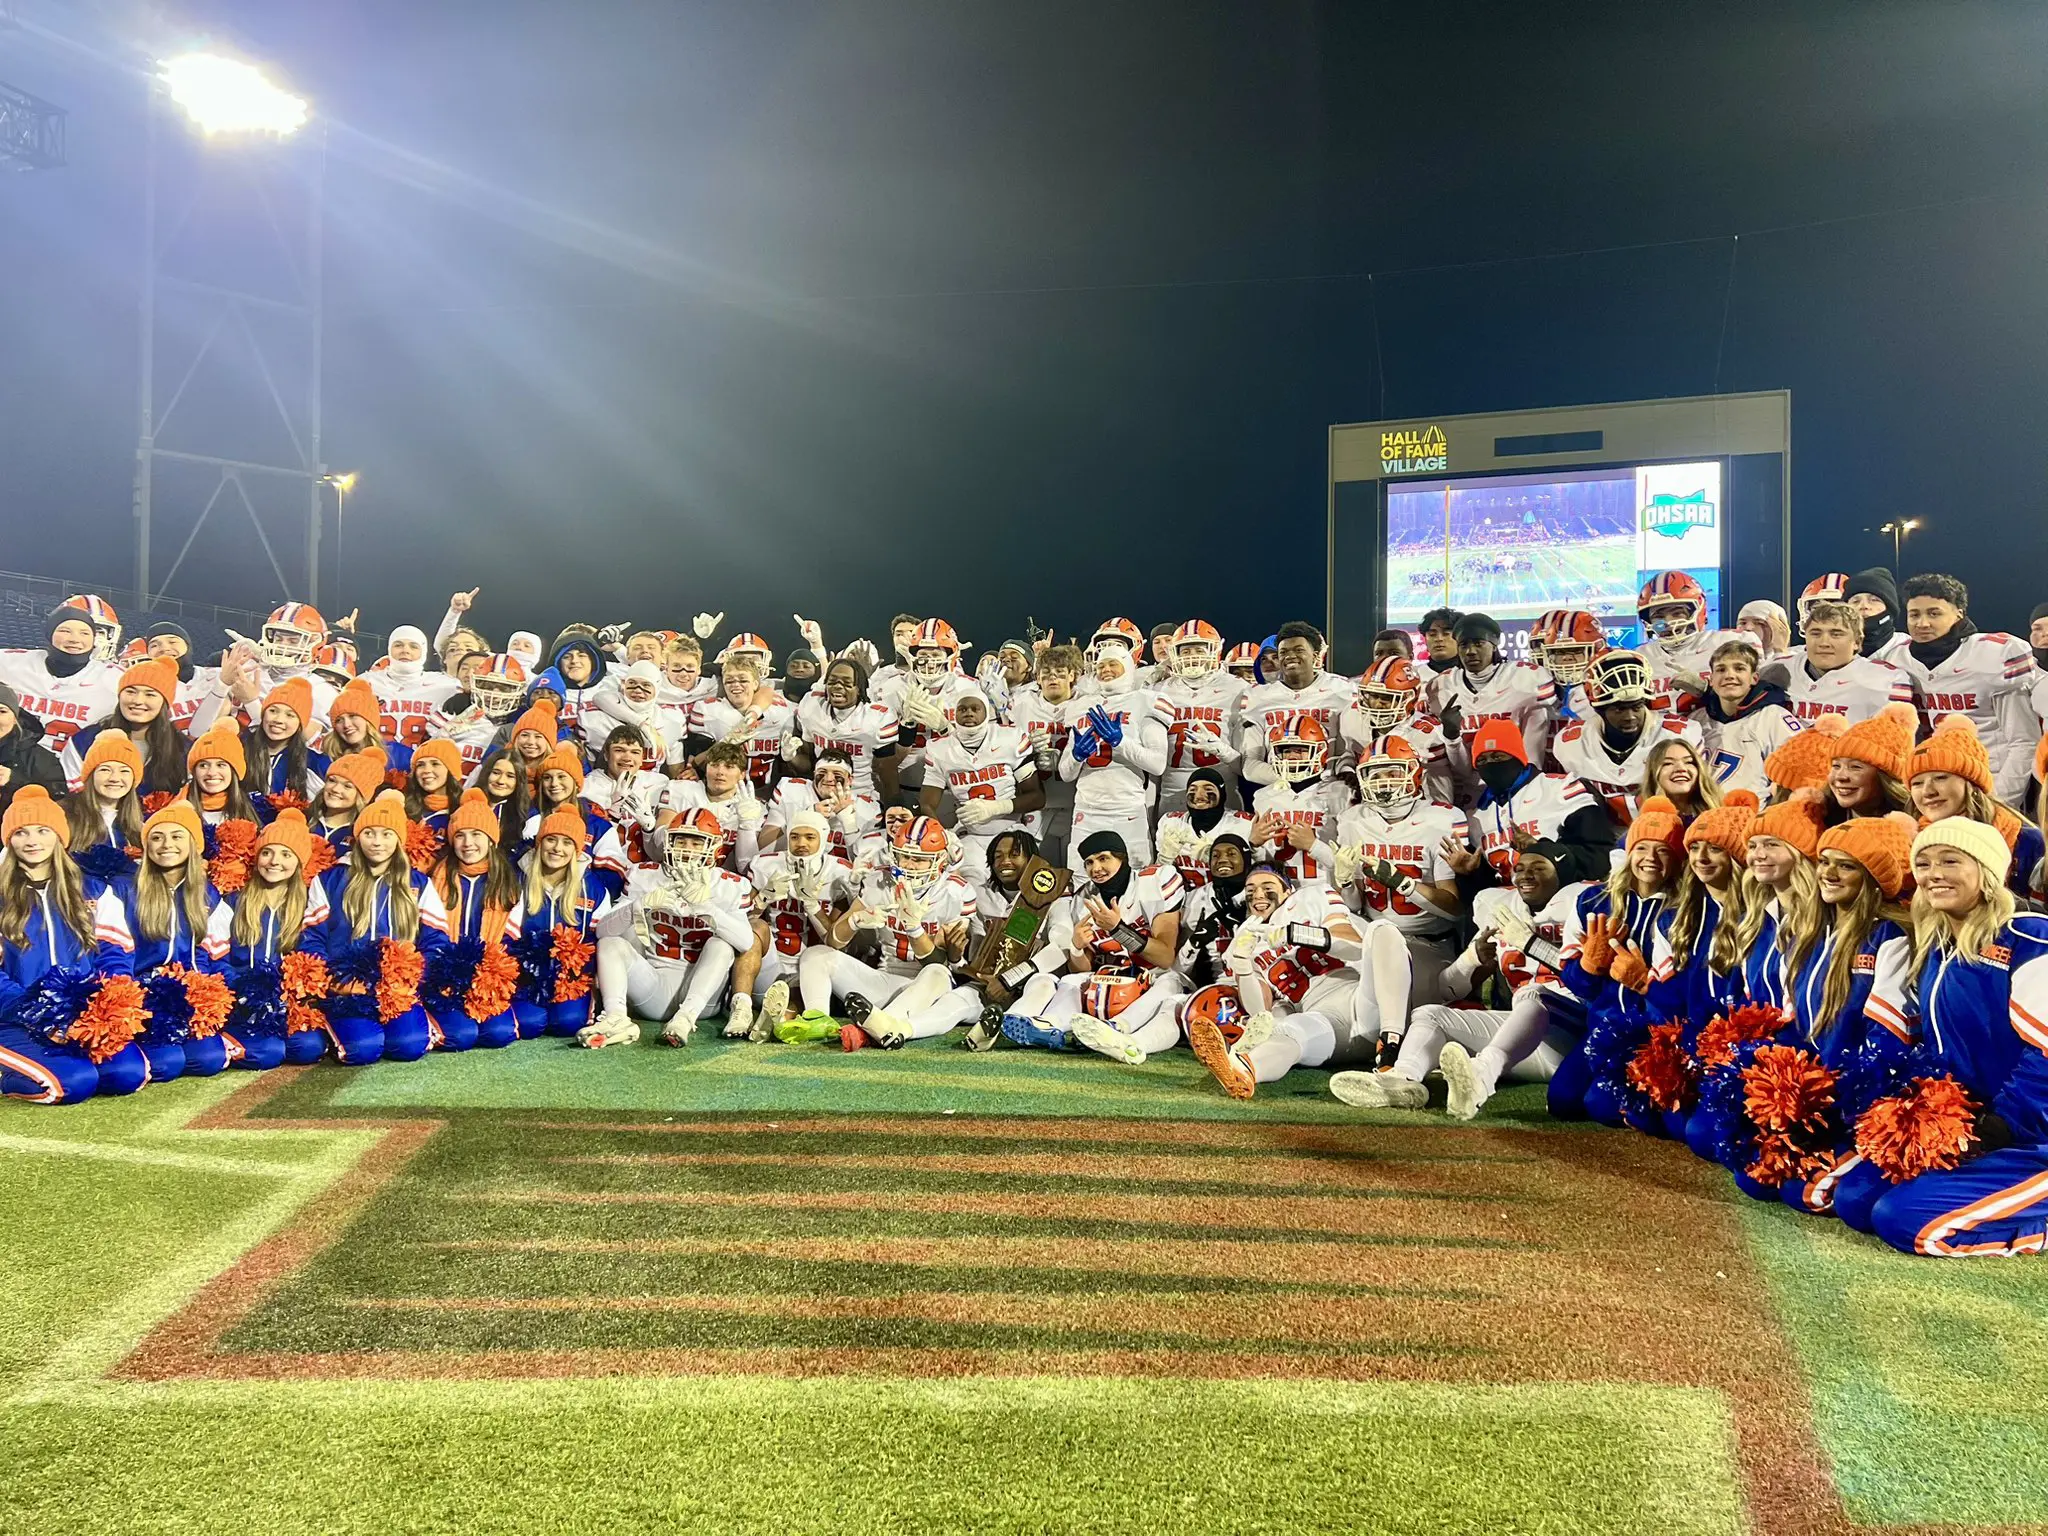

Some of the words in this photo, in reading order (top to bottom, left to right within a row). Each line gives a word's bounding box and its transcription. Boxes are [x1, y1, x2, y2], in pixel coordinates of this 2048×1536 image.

[1381, 430, 1420, 446] HALL
[1380, 446, 1402, 460] OF
[1406, 442, 1447, 458] FAME
[1381, 456, 1447, 474] VILLAGE
[1645, 503, 1712, 527] OHSAA
[379, 700, 432, 715] RANGE
[1174, 707, 1224, 722] RANGE
[949, 763, 1007, 786] ORANGE
[1361, 843, 1424, 861] RANGE
